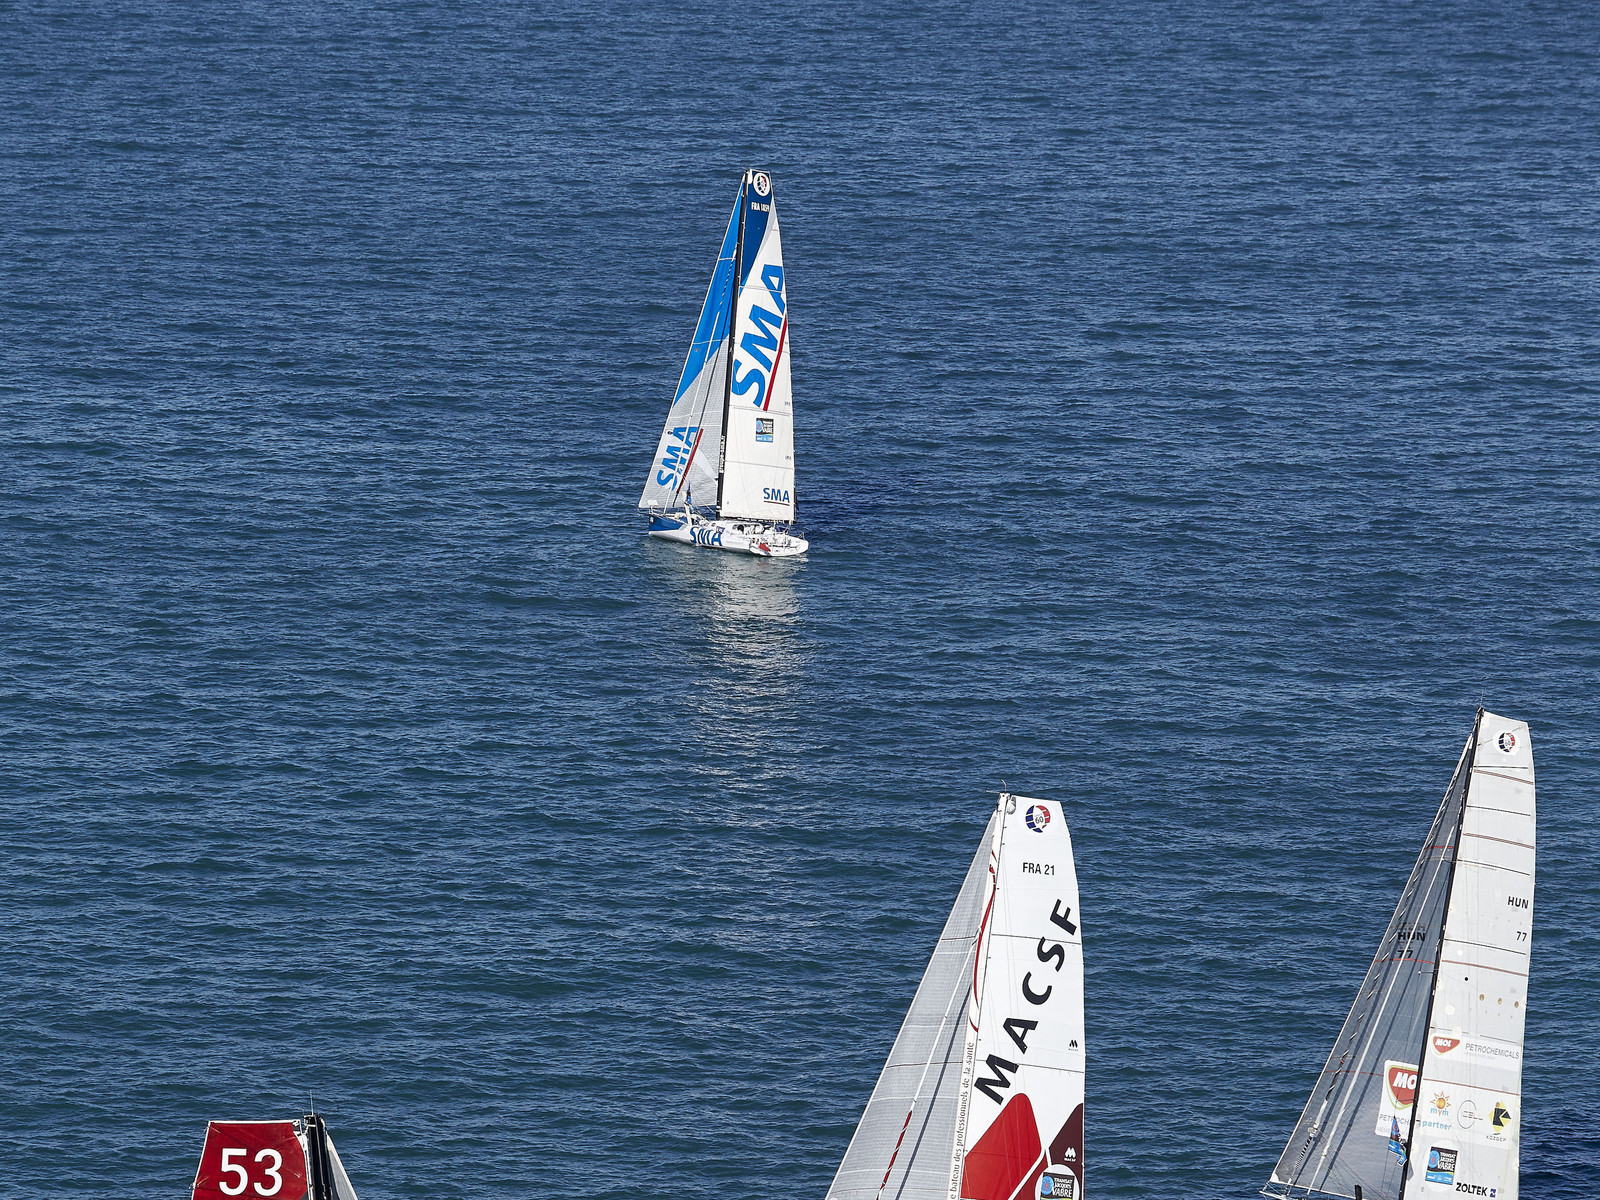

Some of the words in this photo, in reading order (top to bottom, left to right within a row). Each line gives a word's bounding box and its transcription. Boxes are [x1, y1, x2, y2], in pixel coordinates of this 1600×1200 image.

[731, 264, 786, 407] SMA
[657, 427, 699, 490] SMA
[763, 487, 790, 503] SMA
[690, 526, 723, 547] SMA
[1022, 862, 1041, 875] FRA
[1044, 865, 1055, 876] 21
[1507, 896, 1529, 909] HUN
[1397, 931, 1426, 942] HUN
[1516, 931, 1527, 941] 77
[1397, 950, 1414, 959] 77
[973, 899, 1079, 1106] MACSF
[1435, 1037, 1452, 1048] MOL
[1465, 1043, 1520, 1060] PETROCHEMICALS
[1392, 1071, 1417, 1090] MO
[1422, 1120, 1452, 1130] partner
[951, 1164, 960, 1191] bateau
[956, 1092, 968, 1147] professionnels
[963, 1077, 971, 1089] de
[218, 1147, 283, 1197] 53
[1052, 1187, 1073, 1198] VABRE
[1456, 1182, 1488, 1196] ZOLTEK
